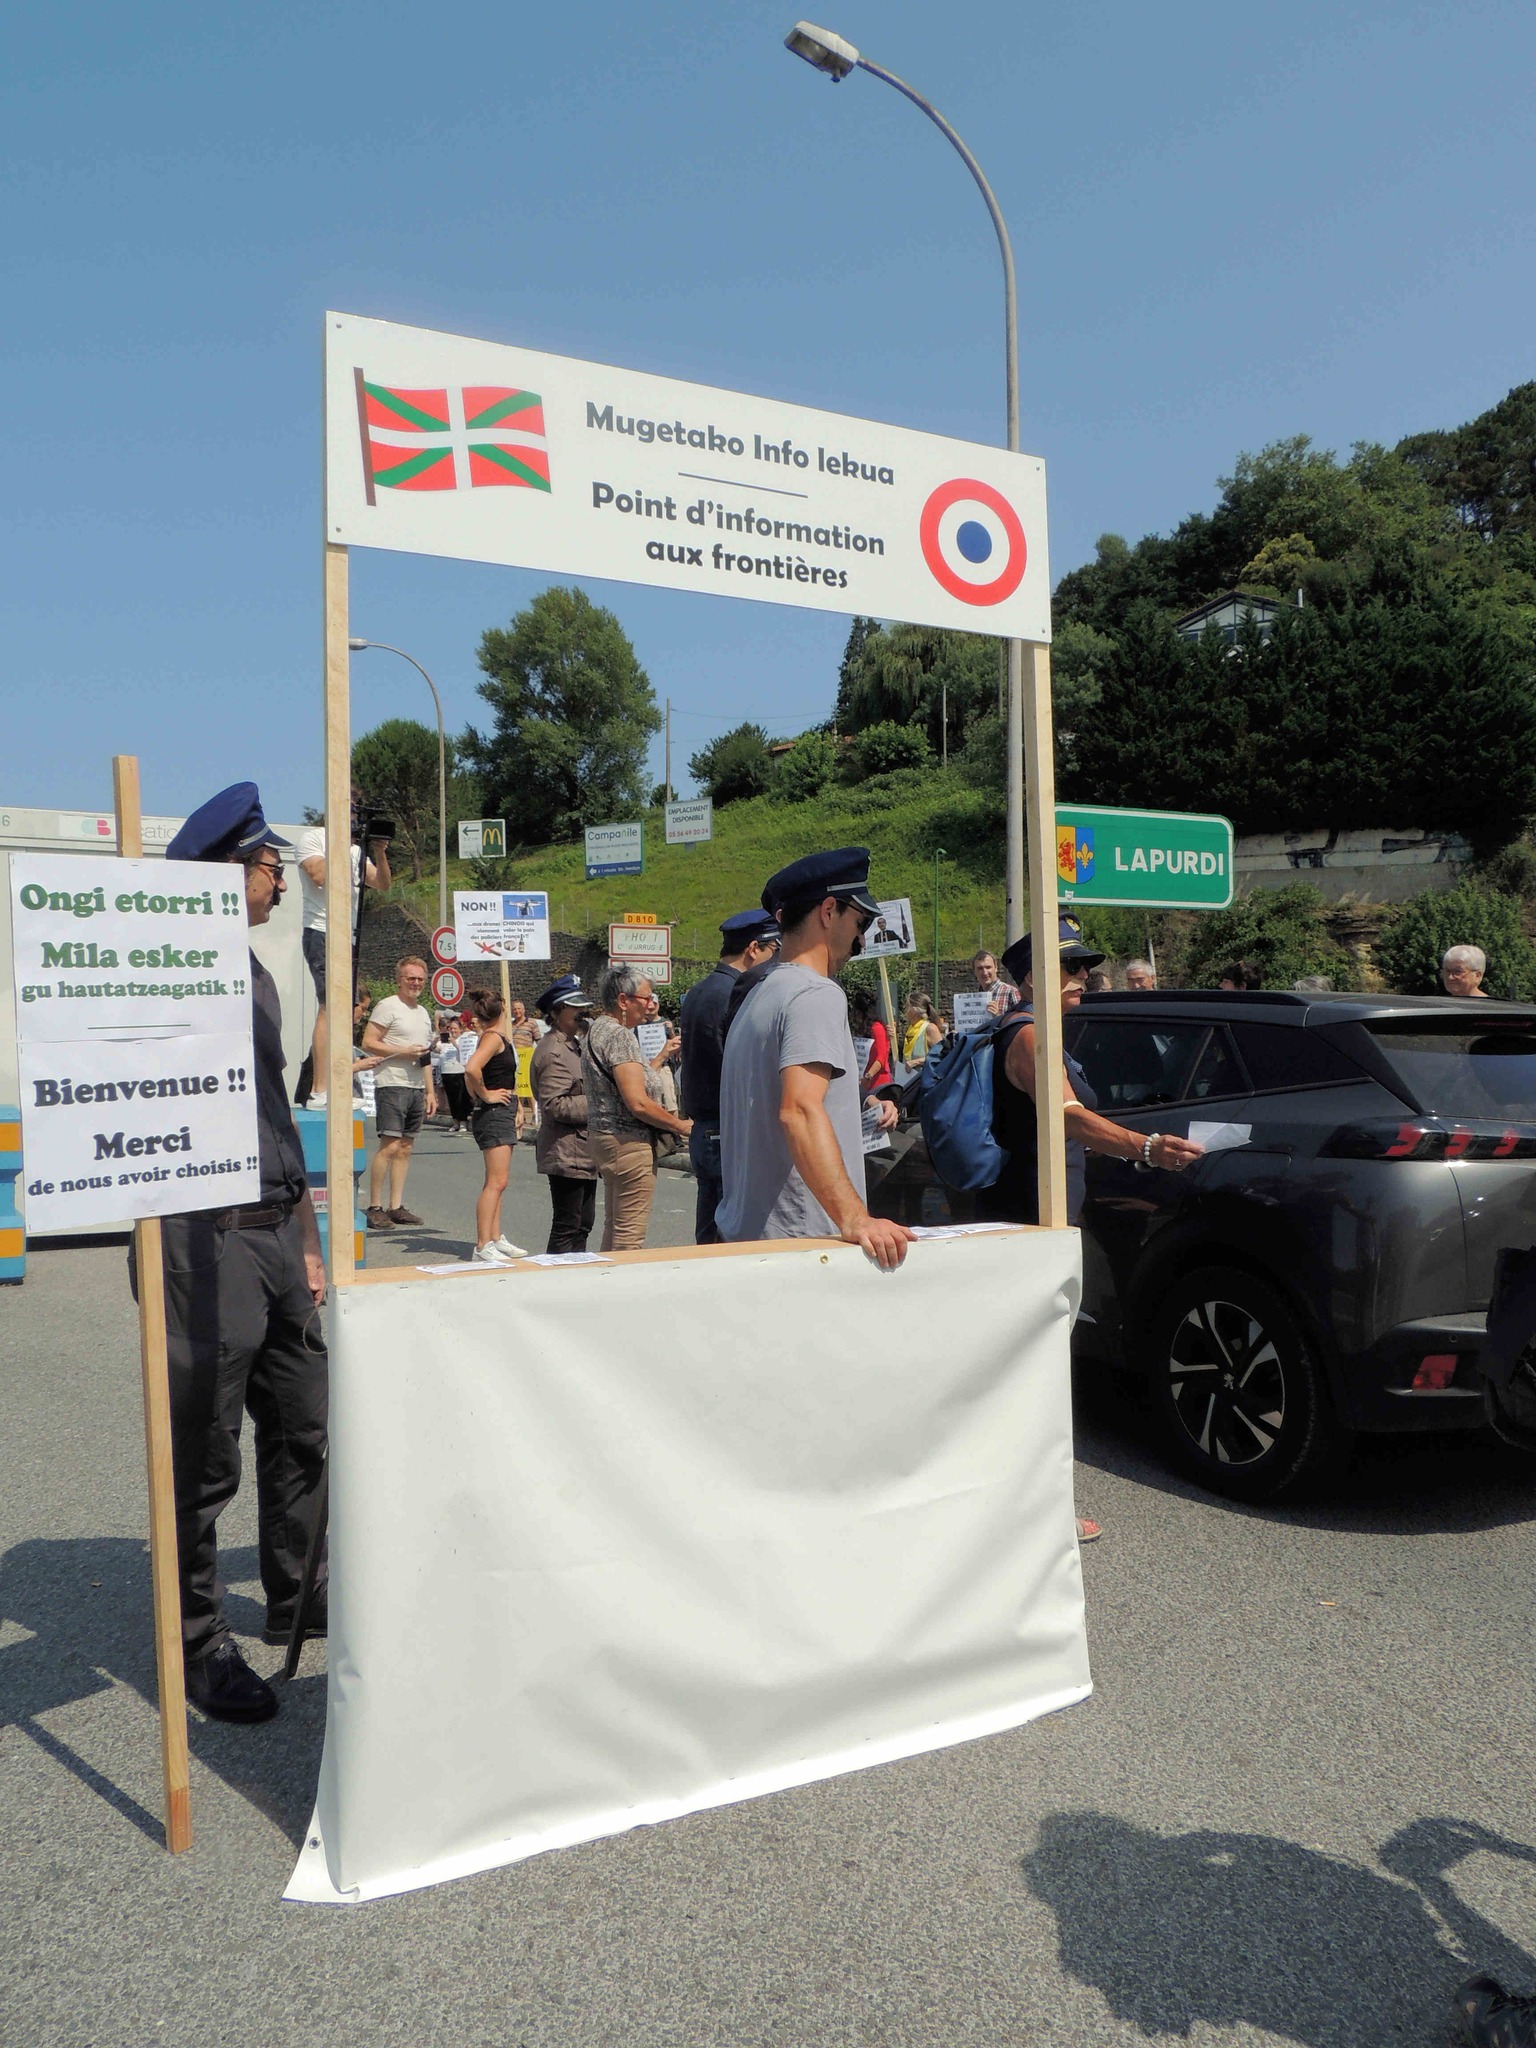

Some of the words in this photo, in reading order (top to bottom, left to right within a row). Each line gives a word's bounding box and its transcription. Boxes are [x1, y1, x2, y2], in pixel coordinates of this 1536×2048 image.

[586, 400, 745, 456] Mugetako
[753, 433, 810, 469] Info
[817, 446, 895, 485] lekua
[591, 481, 677, 521] Point
[686, 499, 885, 556] d'information
[645, 540, 703, 567] aux
[711, 542, 848, 589] frontières
[668, 805, 708, 815] EMPLACEMENT
[672, 814, 704, 823] DISPONIBLE
[588, 827, 638, 841] Campanile
[1115, 846, 1224, 876] LAPURDI
[20, 883, 106, 918] Ongi
[115, 890, 214, 915] etorri
[221, 892, 240, 916] !!
[41, 941, 119, 968] Mila
[128, 943, 219, 969] esker
[21, 983, 52, 1003] gu
[58, 979, 228, 1000] hautatzeagatik
[233, 979, 246, 996] !!
[32, 1074, 219, 1107] Bienvenue
[227, 1067, 247, 1093] !!
[93, 1126, 193, 1160] Merci
[27, 1179, 55, 1196] de
[60, 1173, 113, 1193] nous
[118, 1167, 171, 1185] avoir
[176, 1158, 242, 1179] choisis
[246, 1155, 258, 1171] !!
